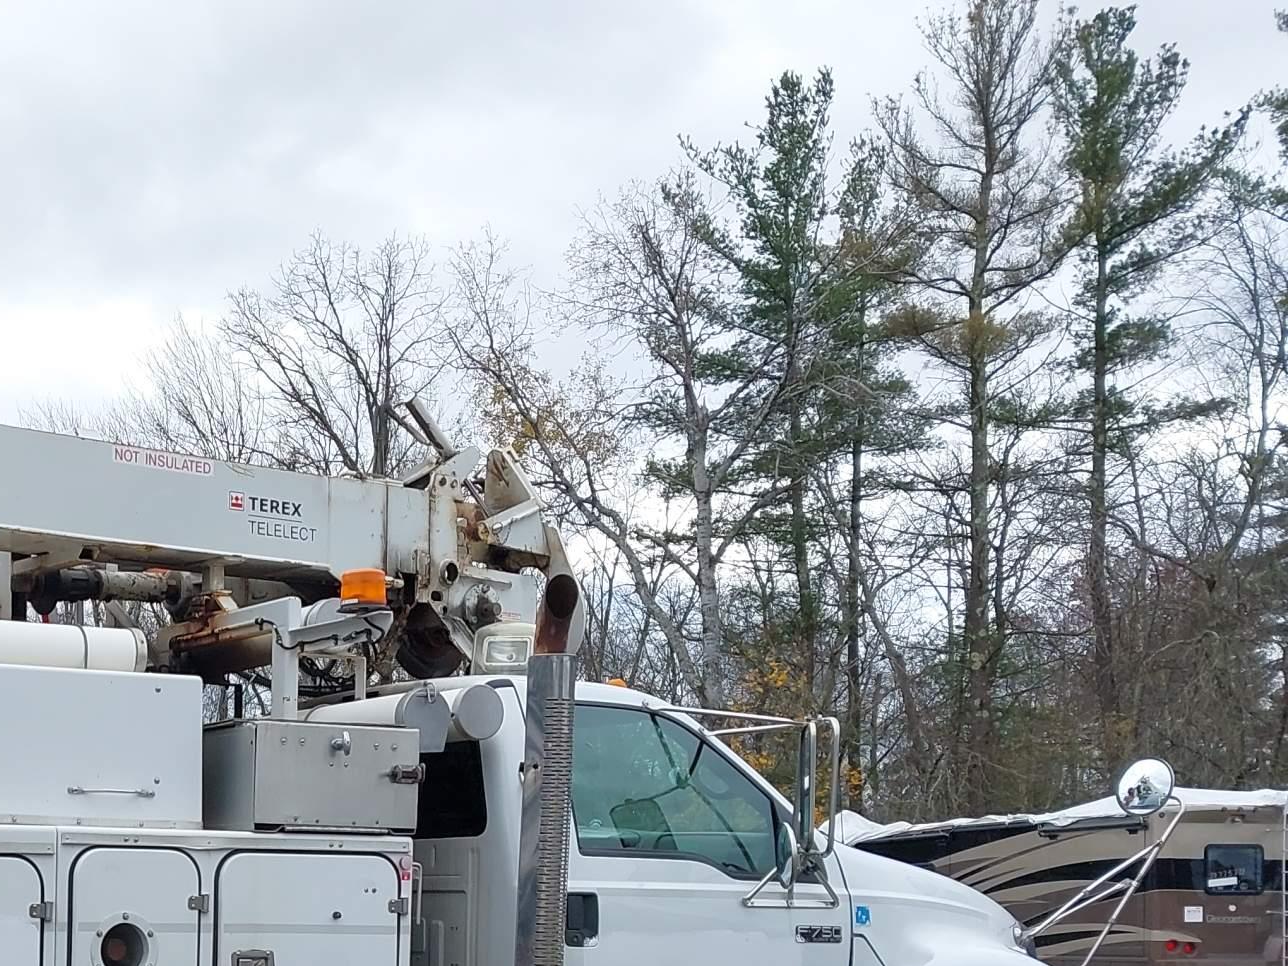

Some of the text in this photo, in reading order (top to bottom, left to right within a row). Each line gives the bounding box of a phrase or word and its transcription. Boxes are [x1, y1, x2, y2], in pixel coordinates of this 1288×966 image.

[114, 448, 211, 474] NOT INSULATED
[248, 496, 302, 517] TEREX
[248, 520, 317, 542] TELELECT
